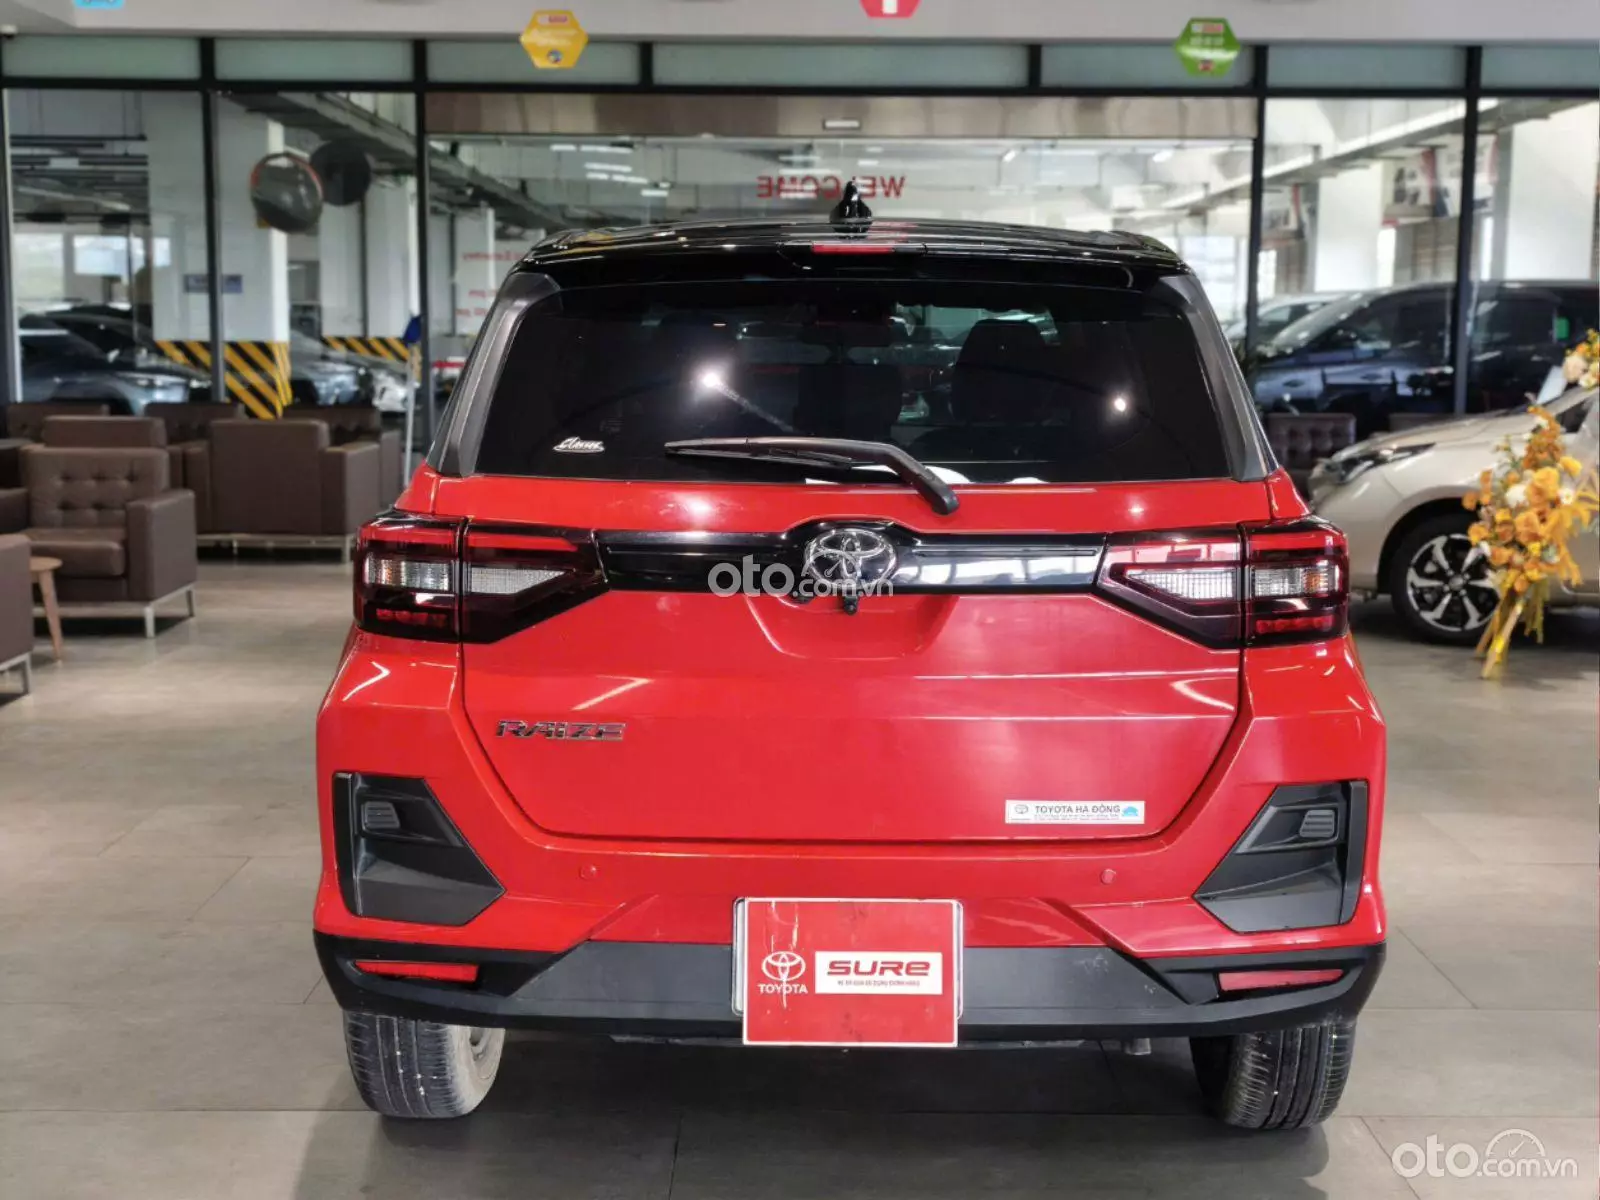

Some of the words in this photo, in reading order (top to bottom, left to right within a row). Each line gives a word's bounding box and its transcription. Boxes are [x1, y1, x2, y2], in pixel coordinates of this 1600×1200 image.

[496, 719, 626, 741] RAIZE
[1035, 804, 1072, 814] TOYOTA
[827, 960, 931, 976] SURE
[757, 983, 808, 994] TOYOTA
